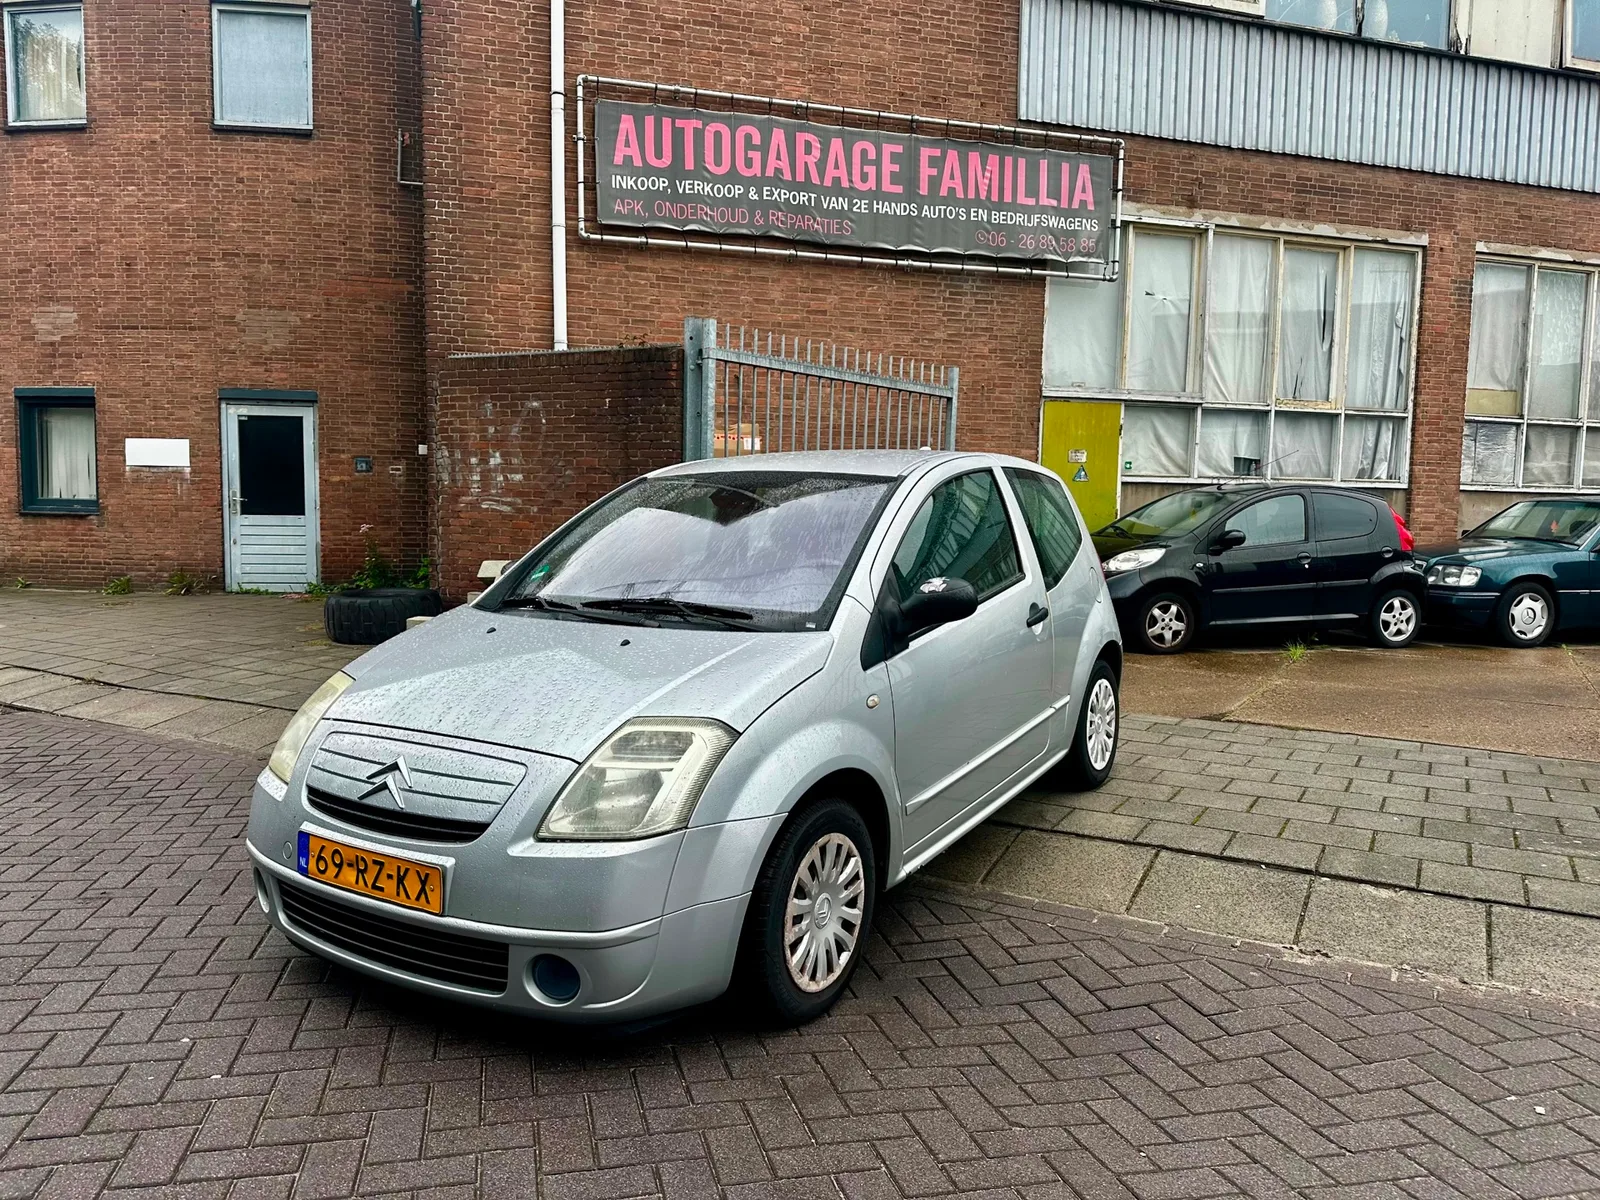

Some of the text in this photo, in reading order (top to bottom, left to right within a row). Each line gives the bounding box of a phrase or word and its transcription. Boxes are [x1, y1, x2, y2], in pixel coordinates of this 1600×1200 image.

[613, 114, 1095, 211] AUTOGARAGE FAMILLIA
[611, 174, 1099, 232] INKOOP, VERKOOP & EXPORT VAN 2E HANDS AUTO'S EN BEDRIJFSWAGENS
[614, 198, 852, 235] APK, ONDERHOUD & REPARATIES
[989, 231, 1007, 247] 06
[1018, 233, 1035, 249] 26
[1039, 234, 1055, 250] 89
[1060, 237, 1076, 252] 58
[1080, 238, 1096, 253] 85
[299, 855, 307, 868] NL
[315, 844, 431, 905] 69-RZ-KX
